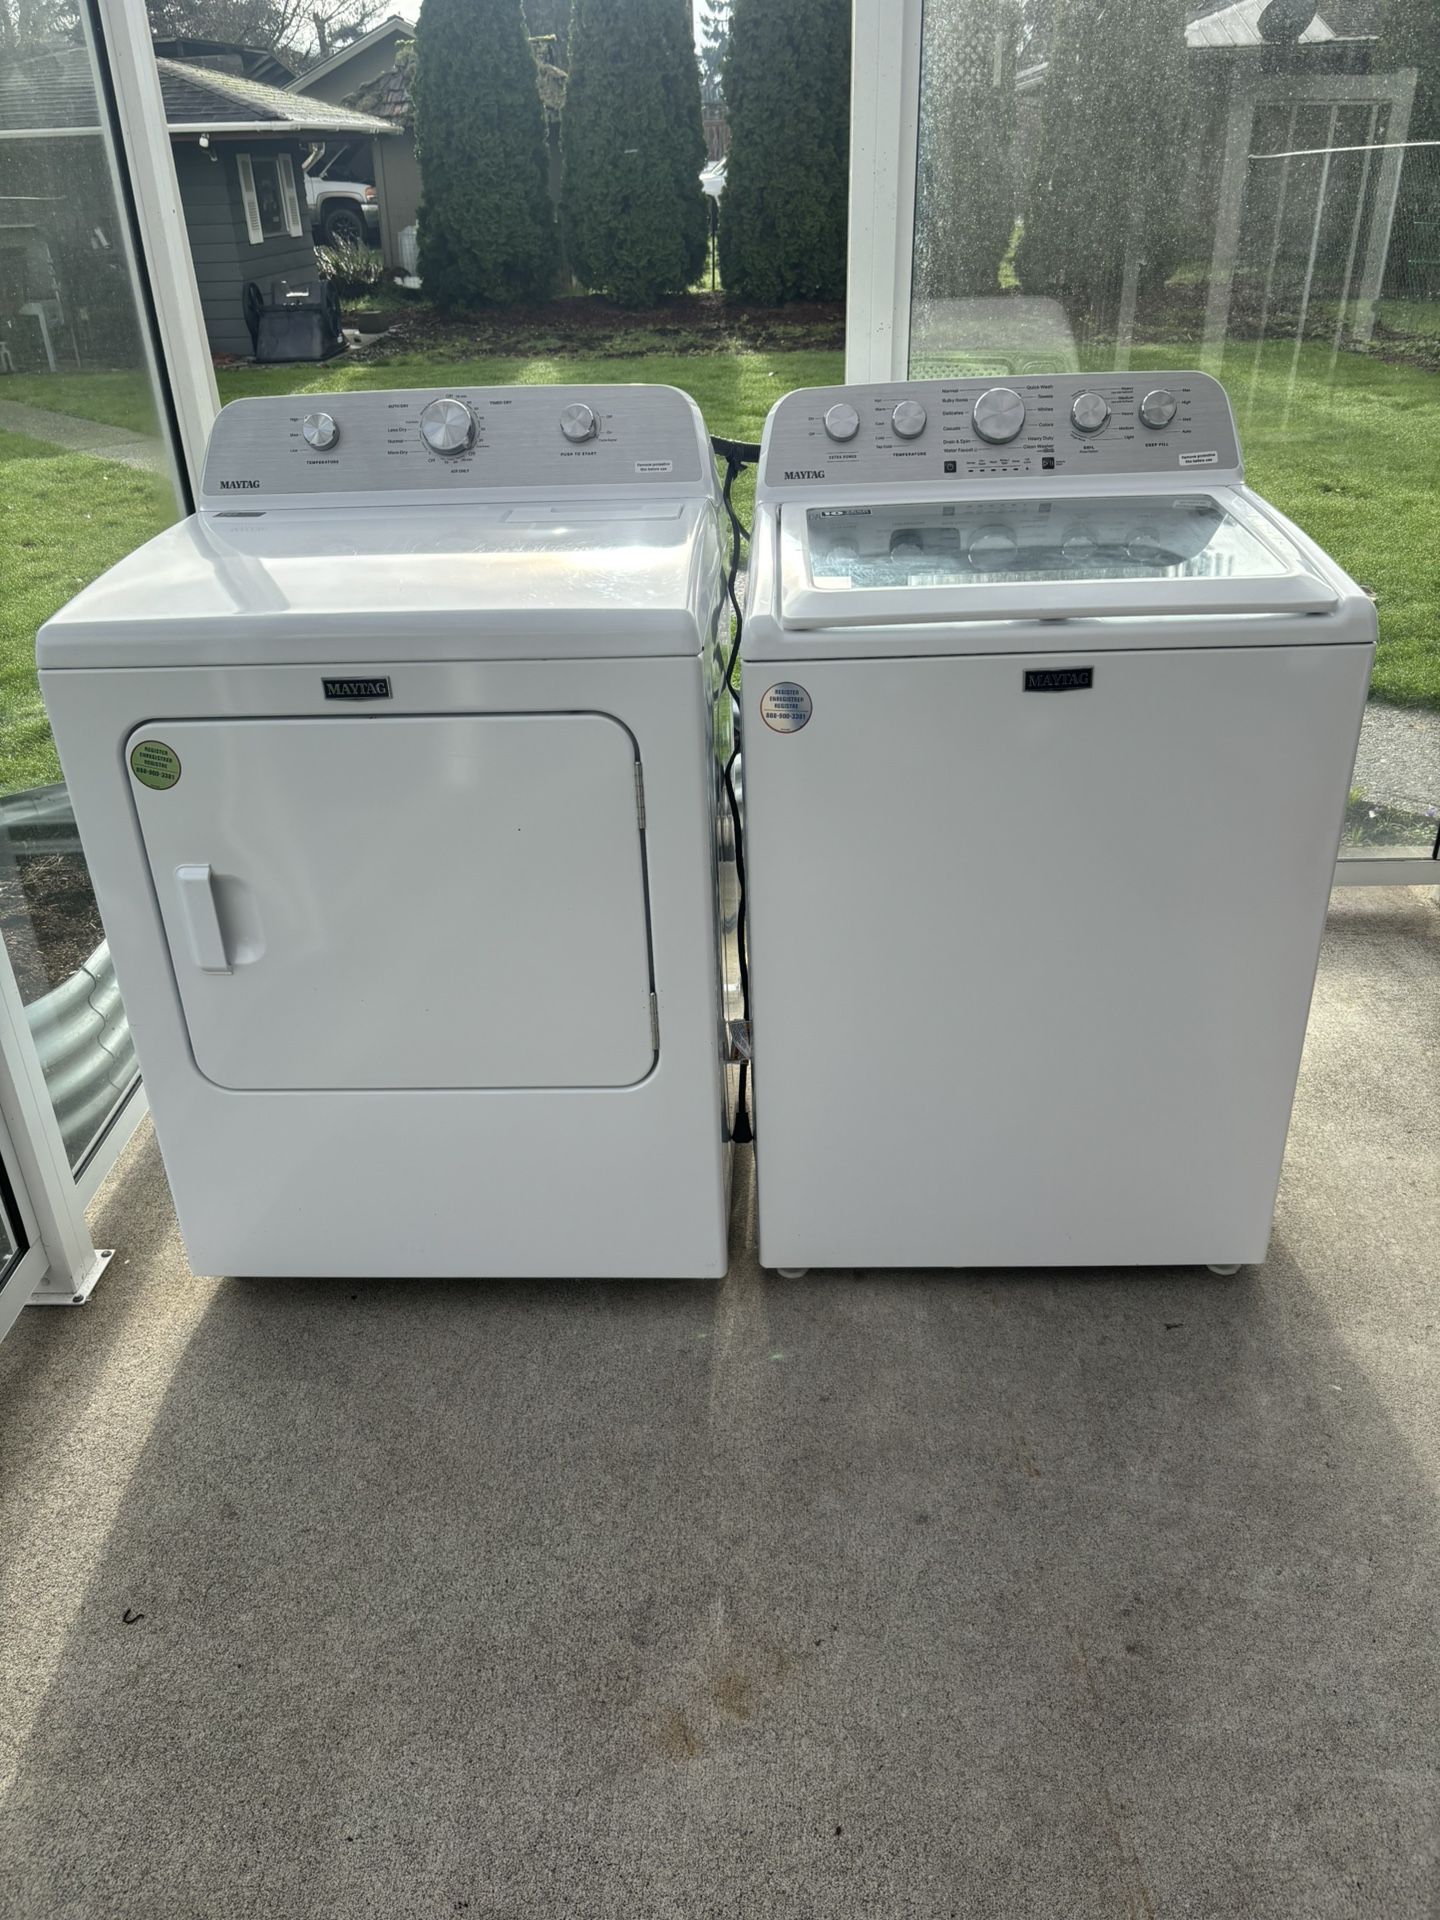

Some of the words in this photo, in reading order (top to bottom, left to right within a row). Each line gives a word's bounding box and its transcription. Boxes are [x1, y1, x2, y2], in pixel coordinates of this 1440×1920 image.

[784, 470, 825, 480] MAYTAG
[219, 480, 260, 490] MAYTAG
[1028, 673, 1089, 687] MAYTAG
[326, 682, 387, 695] MAYTAG
[144, 746, 168, 756] REGISTER
